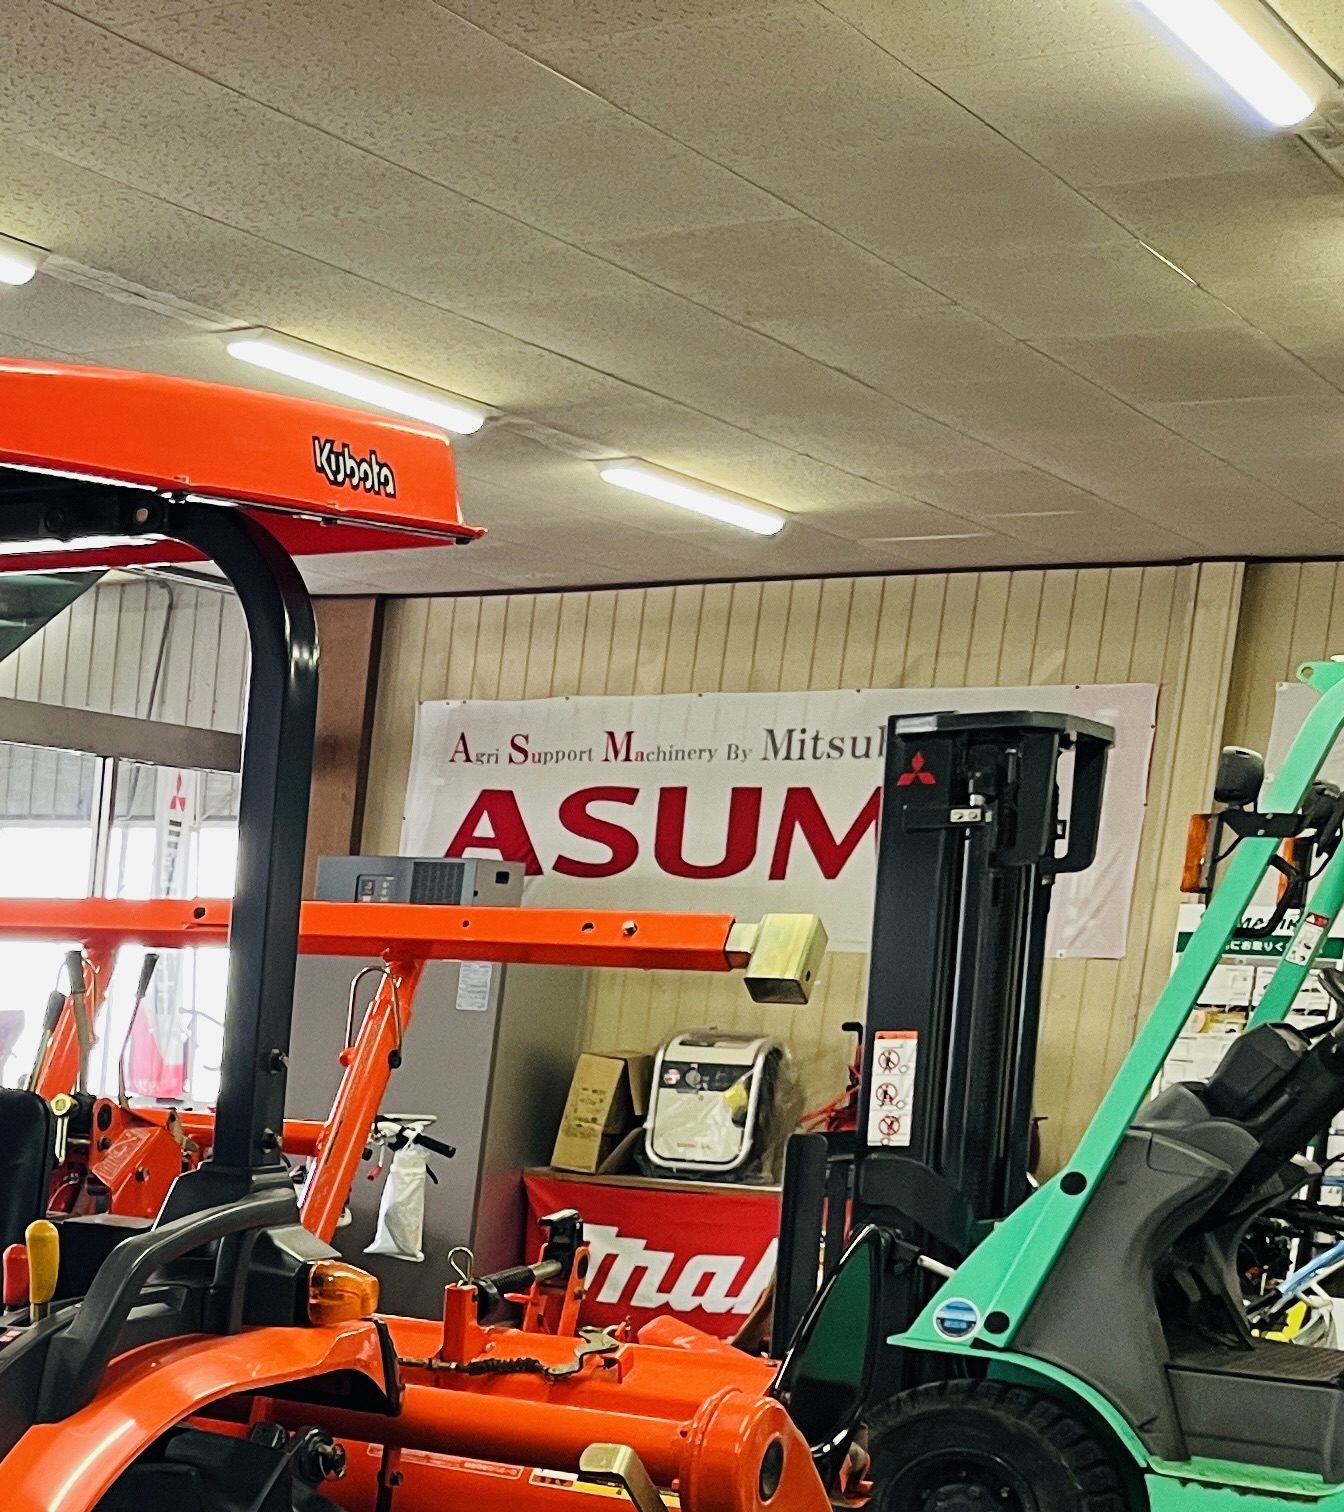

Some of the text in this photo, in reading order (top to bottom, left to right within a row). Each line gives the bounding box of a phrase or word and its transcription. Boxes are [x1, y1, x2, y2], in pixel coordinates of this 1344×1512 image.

[312, 435, 396, 499] Kubota
[448, 731, 500, 766] Agri
[508, 732, 593, 766] Support
[601, 730, 718, 764] Machinery
[726, 743, 753, 764] By
